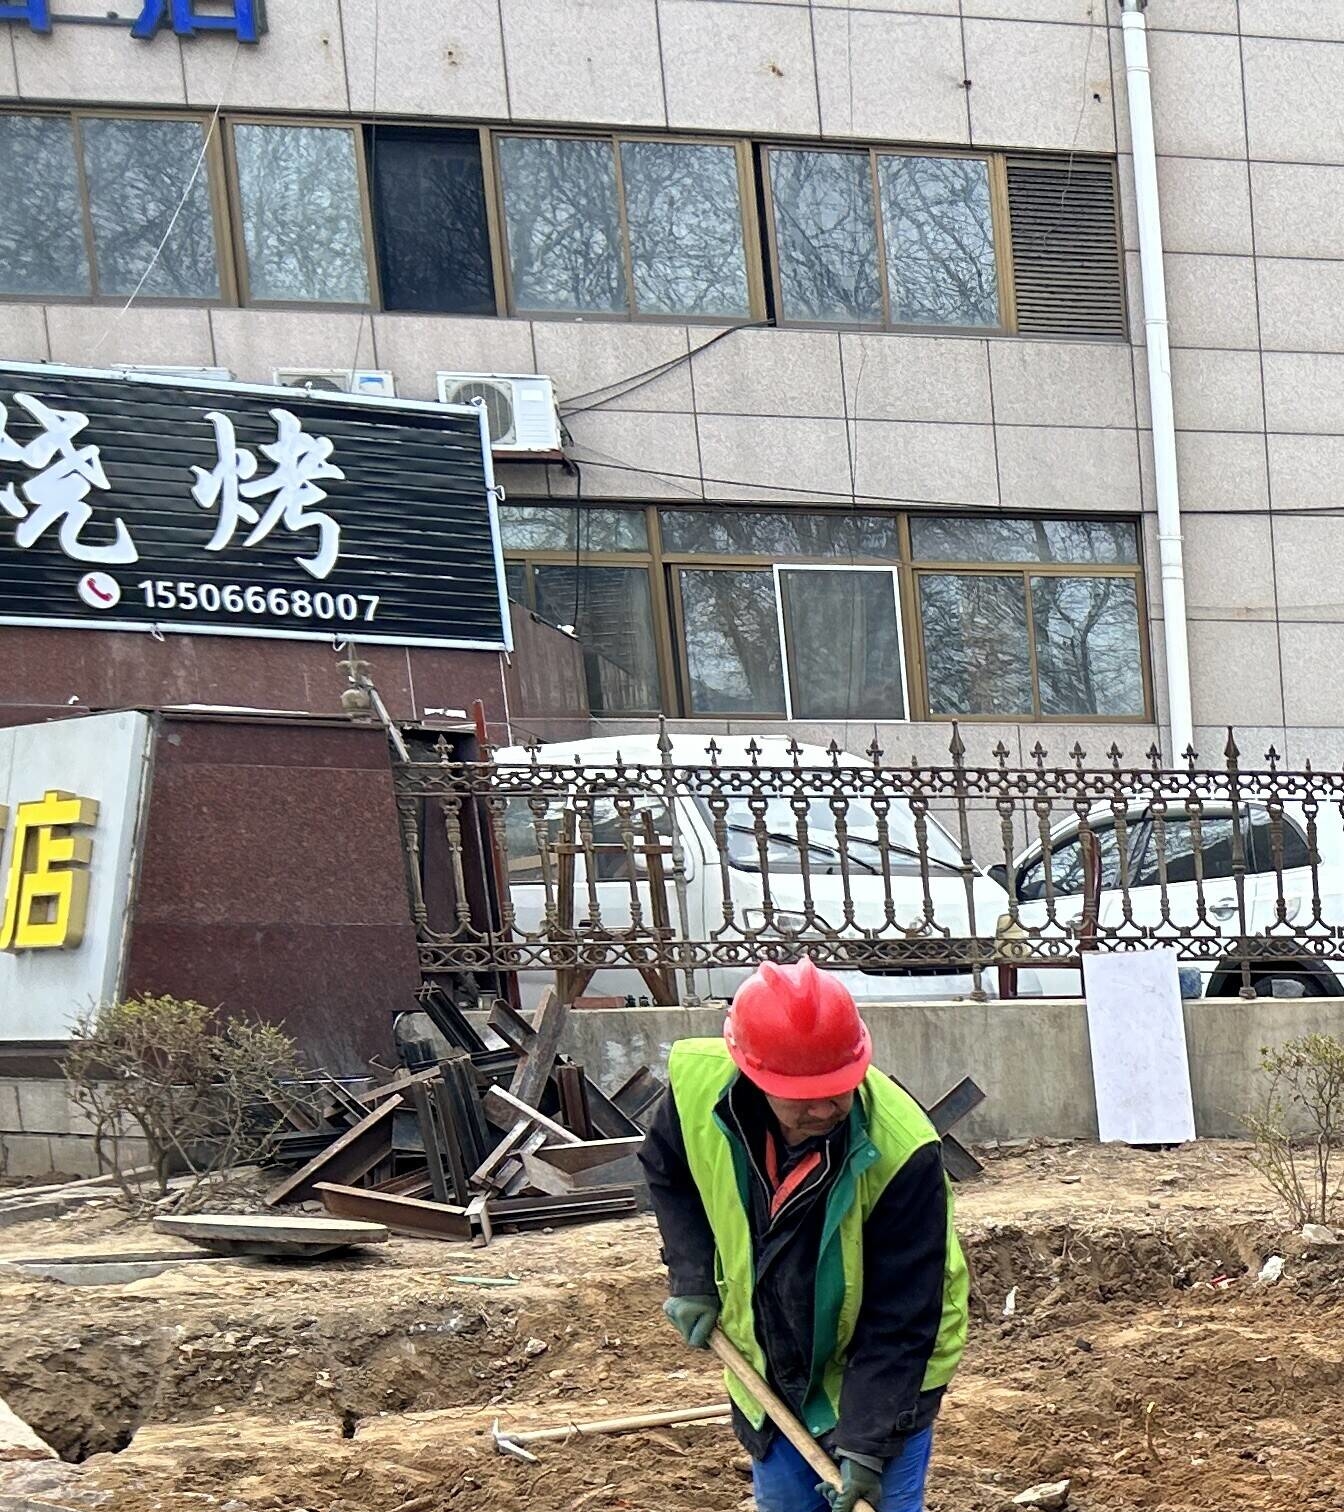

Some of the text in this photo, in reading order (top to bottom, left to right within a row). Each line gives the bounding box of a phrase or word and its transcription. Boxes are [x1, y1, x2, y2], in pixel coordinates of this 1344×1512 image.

[0, 391, 346, 580] 烧烤
[137, 579, 381, 622] 15506668007
[0, 790, 97, 951] 店
